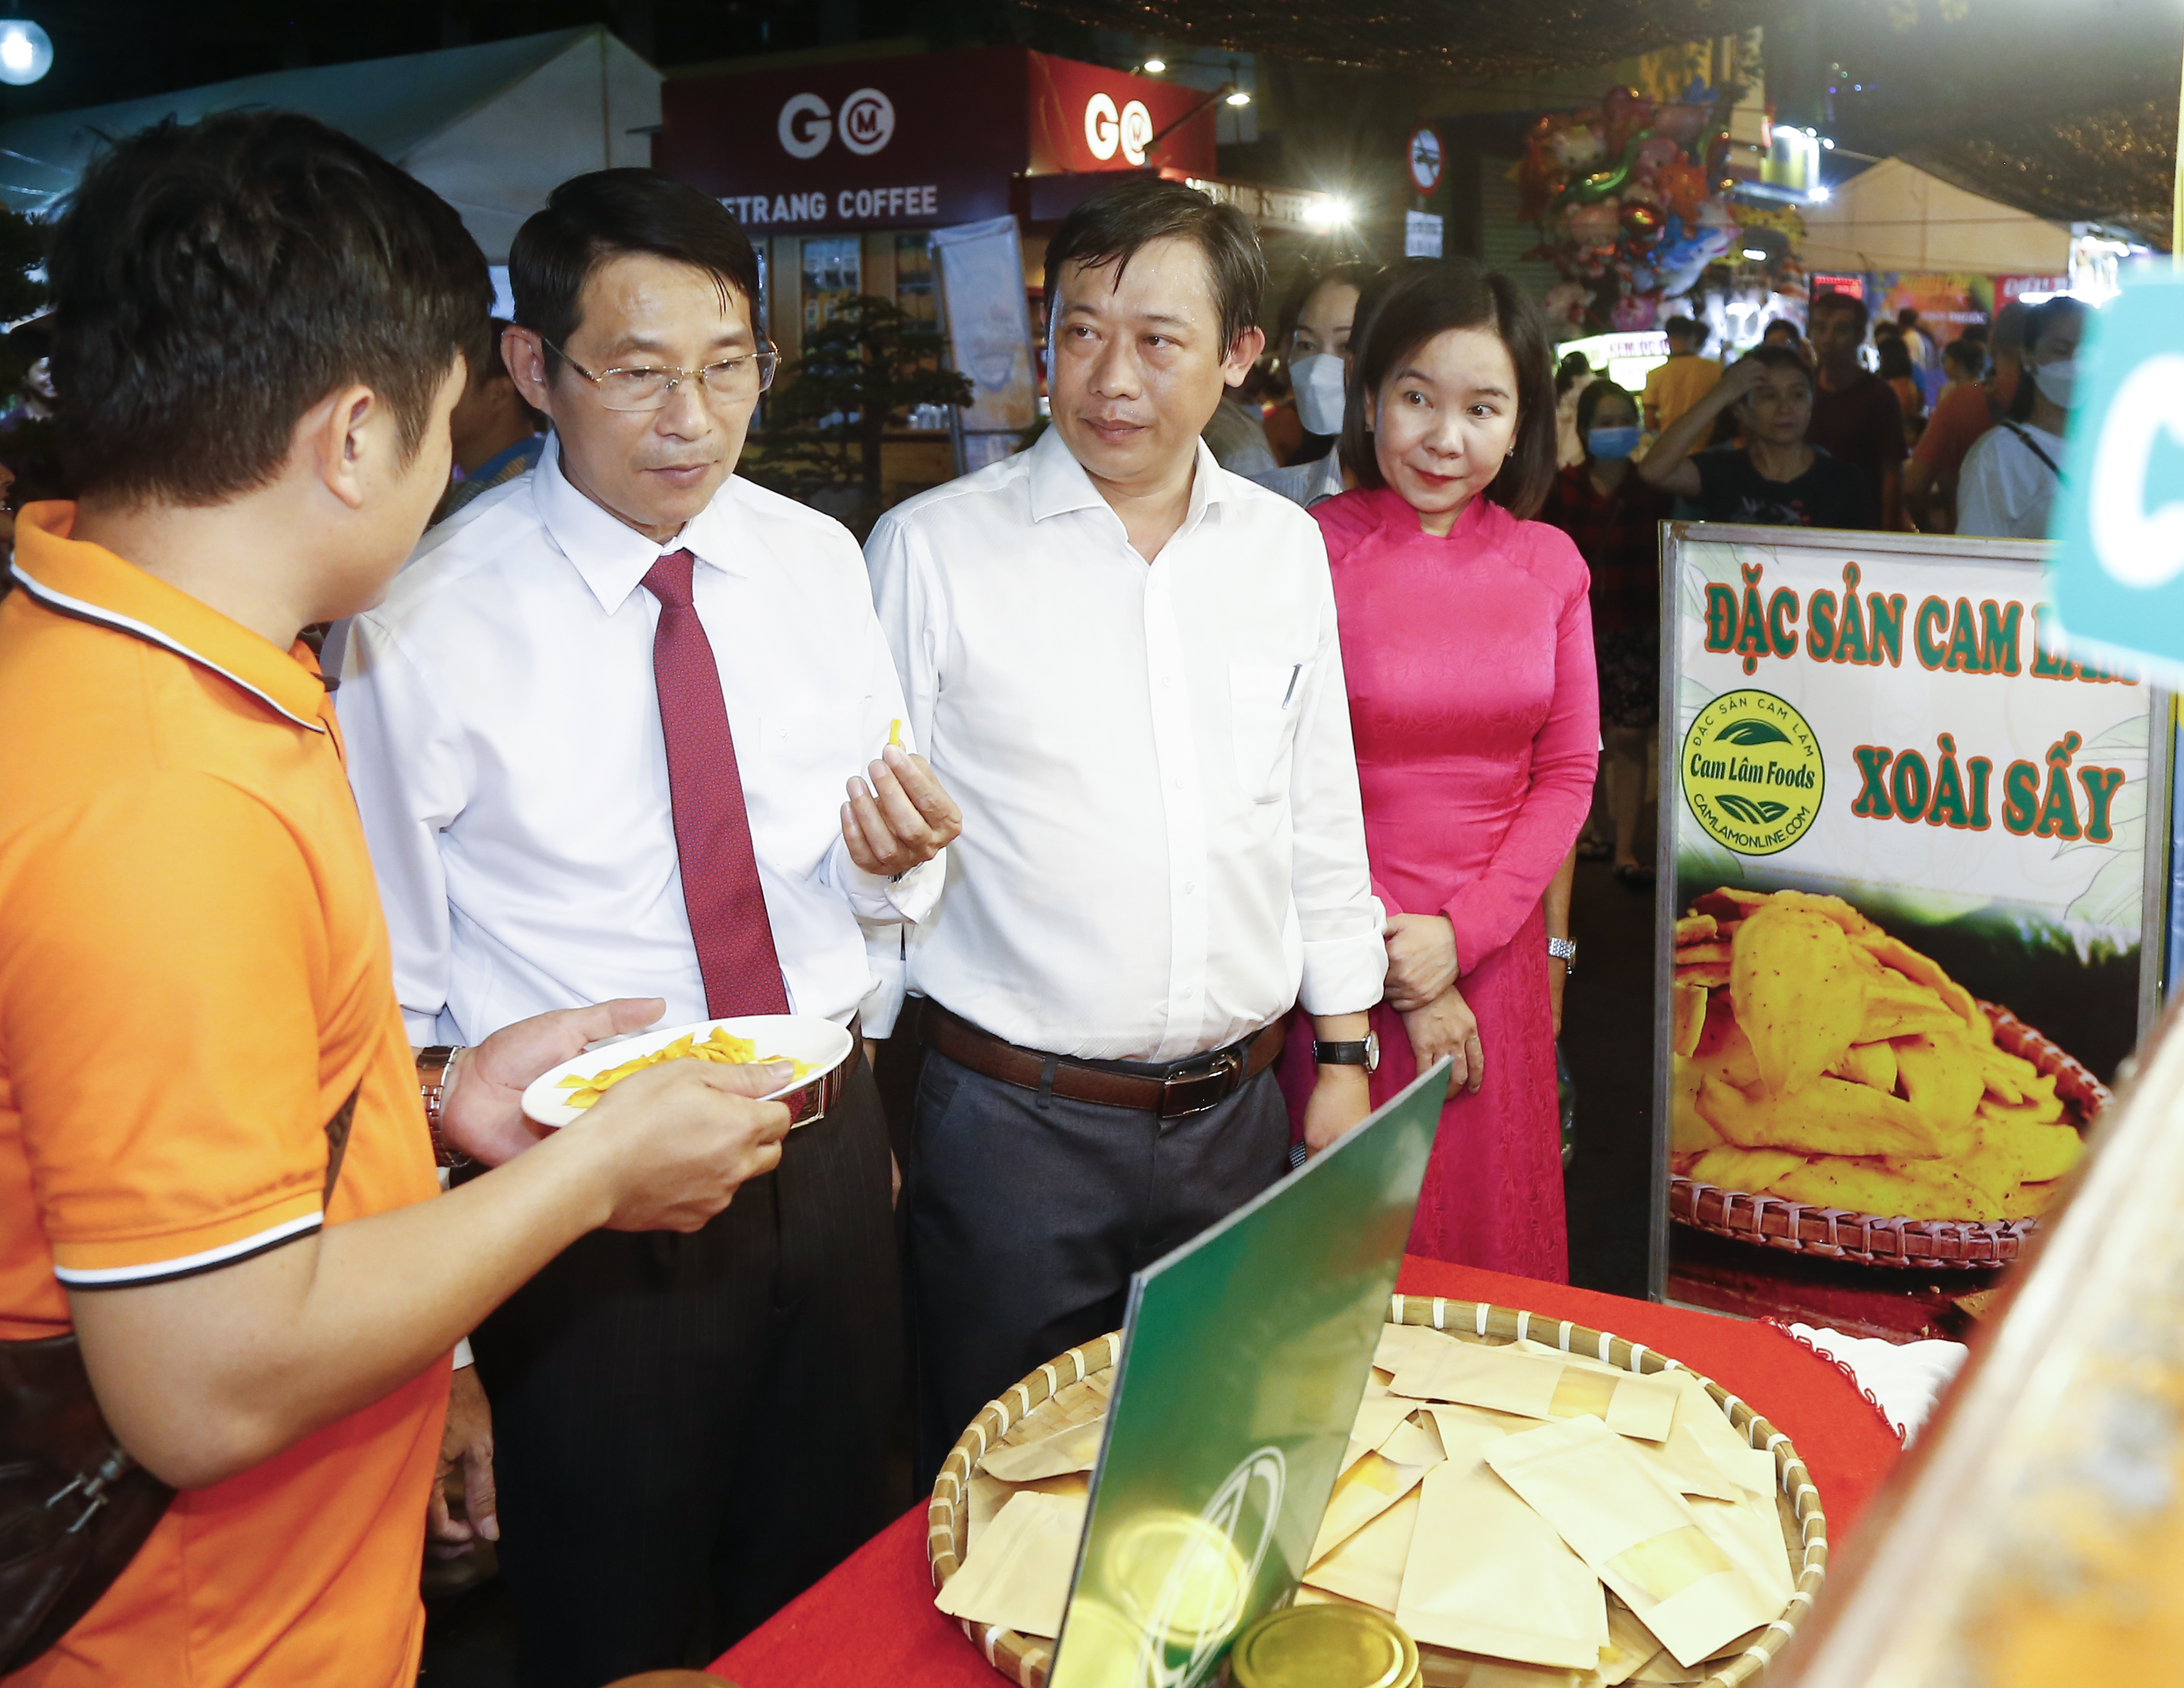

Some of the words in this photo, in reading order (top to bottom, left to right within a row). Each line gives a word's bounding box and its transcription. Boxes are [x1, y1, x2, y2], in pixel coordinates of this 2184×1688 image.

[837, 184, 938, 219] COFFEE
[1704, 561, 1799, 675] ĐẶC
[1806, 561, 1907, 668] SẢN
[1914, 595, 2023, 676] CAM
[1757, 698, 1788, 720] CAM
[1690, 753, 1726, 780] Cam
[1728, 757, 1764, 784] Lâm
[1766, 761, 1815, 790] Foods
[1851, 732, 1993, 830] XOÀI
[2002, 731, 2126, 844] SẤY
[1694, 793, 1811, 848] CAMLAMONLINE.COM
